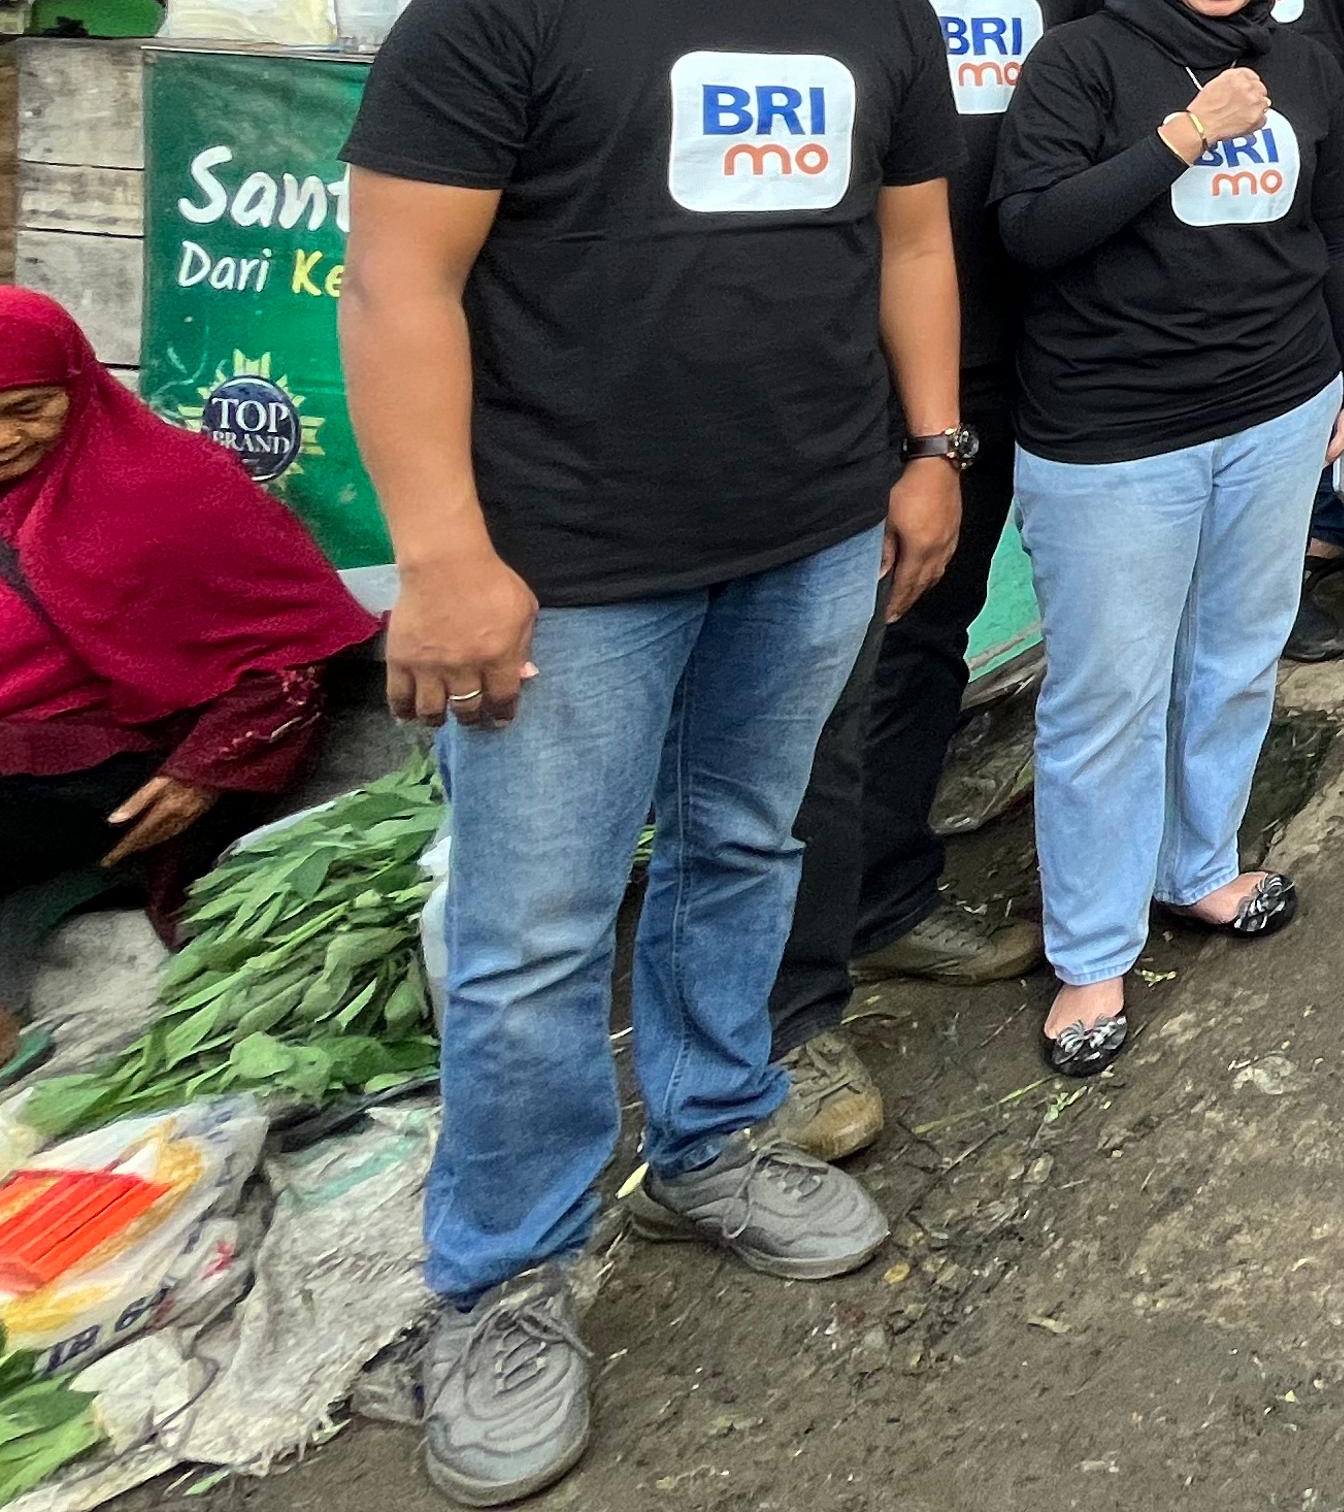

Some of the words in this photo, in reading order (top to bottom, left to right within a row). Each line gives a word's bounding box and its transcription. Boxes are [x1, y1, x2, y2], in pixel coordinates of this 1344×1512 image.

[938, 16, 1022, 56] BRI
[958, 61, 1021, 87] mo
[702, 84, 826, 136] BRI
[724, 143, 829, 176] mo
[177, 145, 350, 232] Sant
[1212, 169, 1283, 196] mo
[177, 239, 273, 293] Dari
[211, 398, 290, 433] TOP
[211, 430, 291, 456] BRAND
